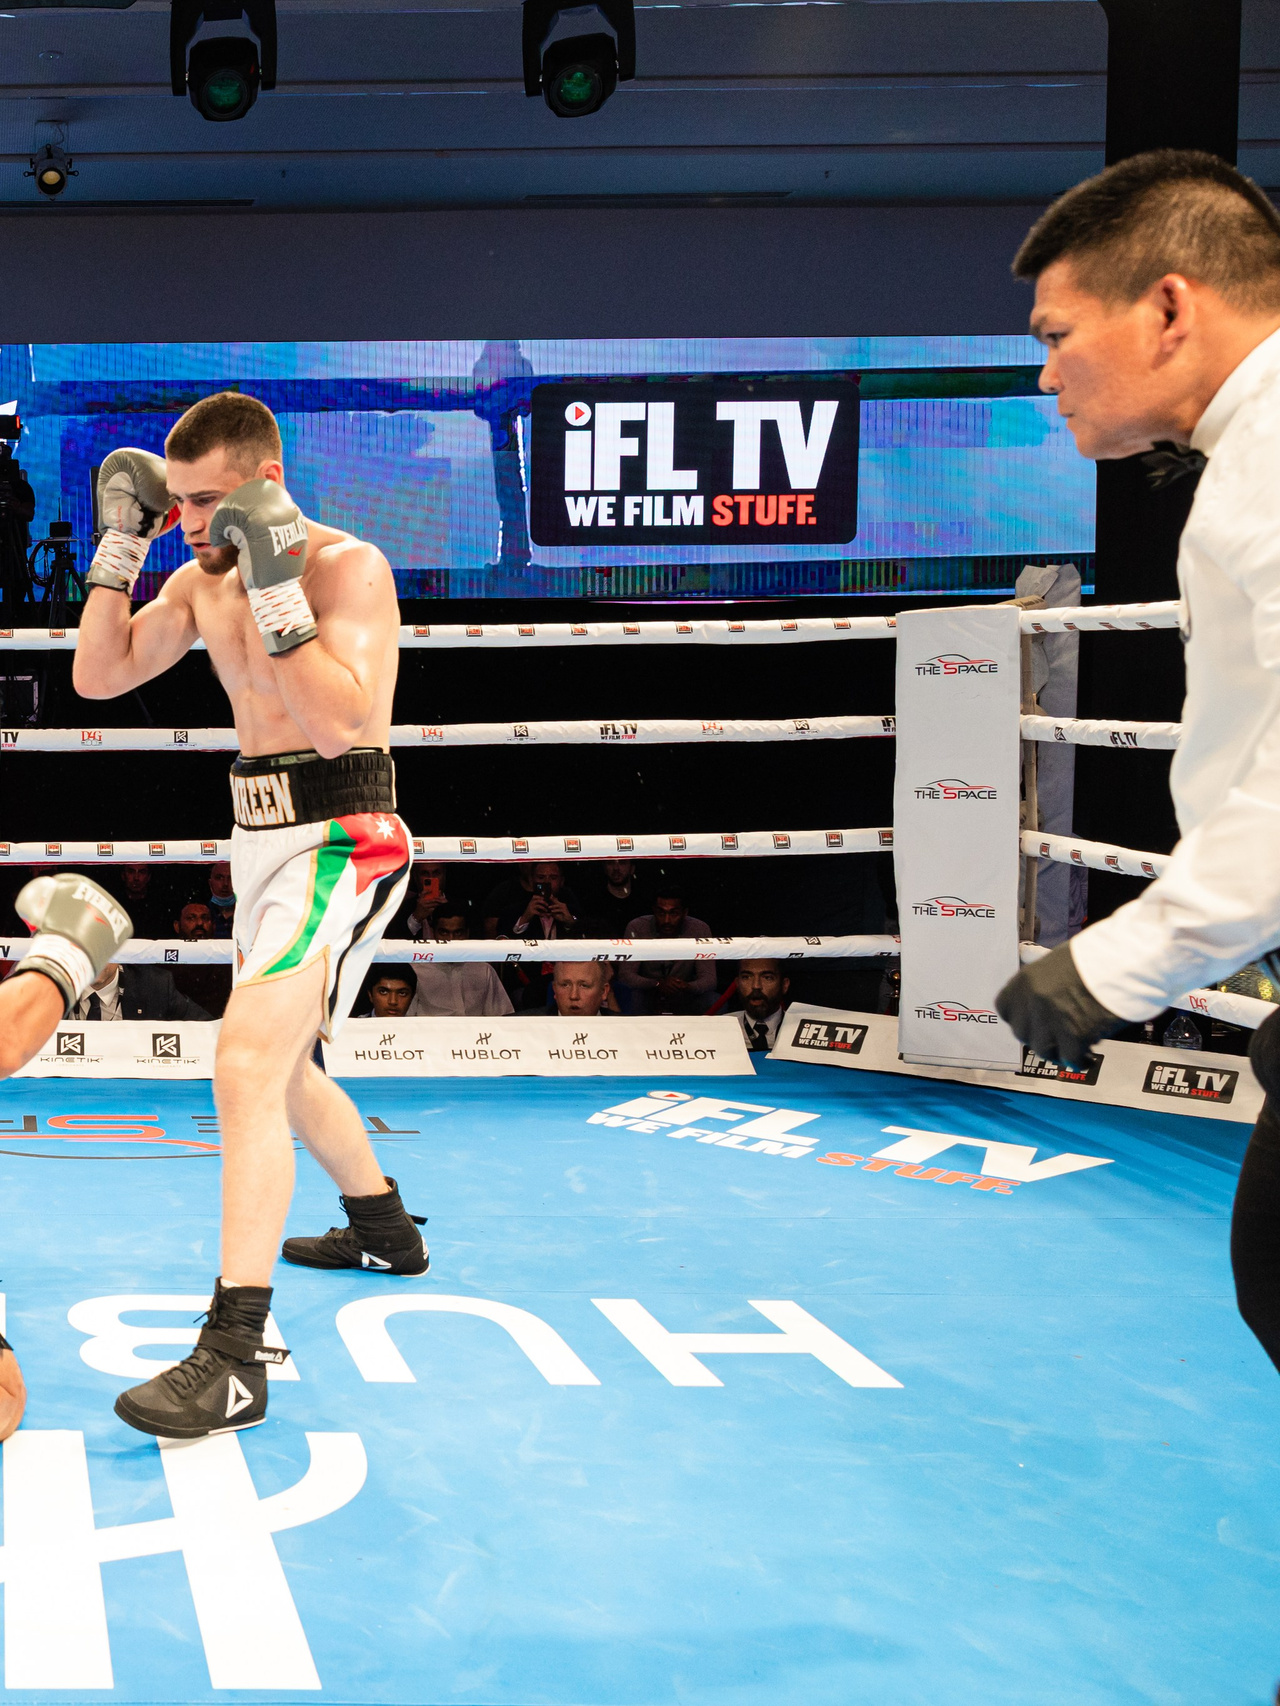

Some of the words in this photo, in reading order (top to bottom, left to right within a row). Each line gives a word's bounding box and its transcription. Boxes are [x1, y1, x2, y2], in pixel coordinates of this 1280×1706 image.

[565, 401, 697, 490] iFL
[716, 400, 839, 489] TV
[564, 496, 616, 526] WE
[624, 495, 704, 526] FILM
[712, 494, 818, 525] STUFF.
[915, 666, 940, 675] THE
[944, 662, 998, 675] SPACE
[600, 724, 619, 735] iFL
[621, 723, 638, 735] TV
[2, 731, 19, 742] TV
[914, 790, 940, 799] THE
[943, 787, 997, 799] SPACE
[912, 905, 938, 916] THE
[941, 905, 995, 918] SPACE
[915, 1009, 941, 1019] THE
[944, 1010, 998, 1024] SPACE
[800, 1023, 829, 1040] iFL
[835, 1026, 862, 1044] TV
[355, 1050, 424, 1060] HUBLOT
[452, 1050, 521, 1060] HUBLOT
[549, 1049, 618, 1060] HUBLOT
[646, 1049, 716, 1060] HUBLOT
[1023, 1066, 1037, 1074] WE
[1151, 1065, 1189, 1087] iFL
[1196, 1071, 1231, 1092] TV
[1150, 1082, 1166, 1091] WE
[586, 1112, 659, 1134] WE
[667, 1126, 816, 1159] FILM
[601, 1090, 822, 1146] iFL
[871, 1125, 1115, 1183] TV
